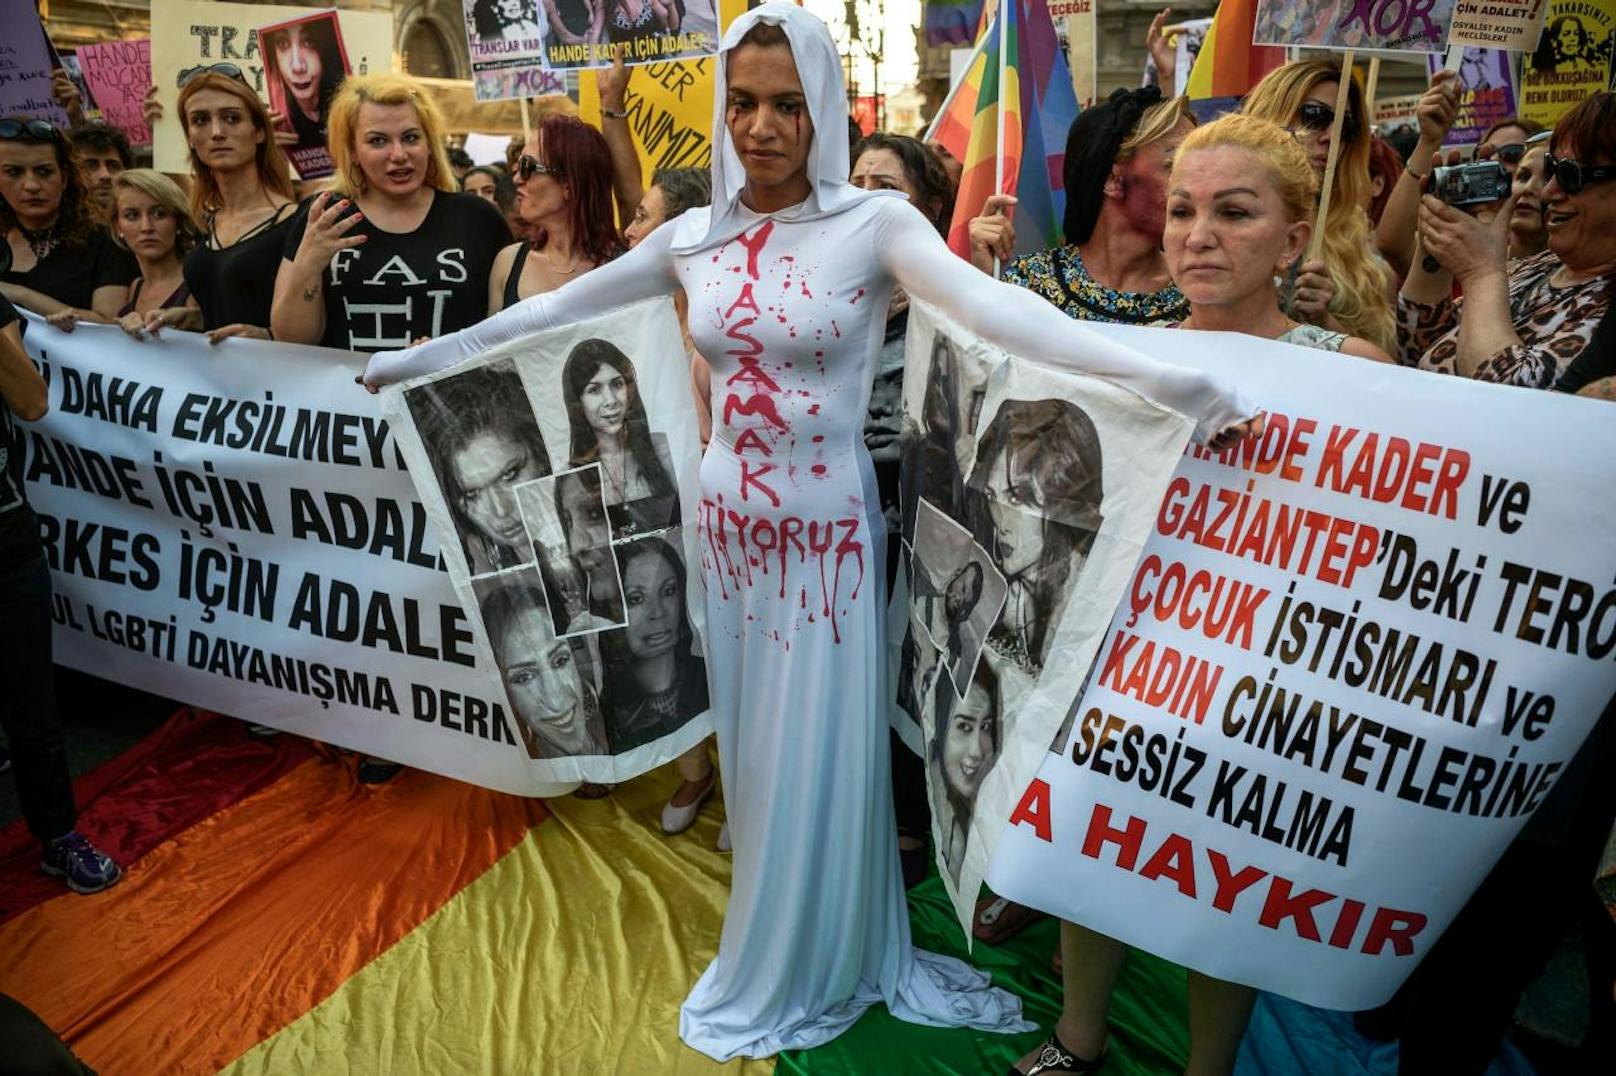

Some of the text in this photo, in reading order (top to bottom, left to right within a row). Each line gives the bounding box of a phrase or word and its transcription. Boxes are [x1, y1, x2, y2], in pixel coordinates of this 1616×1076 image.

[549, 46, 590, 63] HANDE
[634, 35, 658, 60] İÇİN
[1494, 25, 1524, 35] KADIN
[330, 248, 468, 286] FAS
[60, 366, 164, 434] DAHA
[153, 450, 275, 539] İÇİN
[290, 489, 448, 573] ADAL
[1315, 424, 1472, 521] KADER
[1476, 473, 1531, 534] ve
[178, 530, 280, 623] İÇİN
[288, 573, 476, 669] ADALE
[1125, 554, 1556, 741] ÇOCUK İSTİSMARI ve
[87, 604, 177, 662] LGBTİ
[187, 632, 400, 715] DAYANIŞMA
[1097, 630, 1565, 818] KADIN CİNAYETLERİNE
[1072, 706, 1356, 868] SESSİZ KALMA
[1080, 803, 1429, 957] HAYKIR
